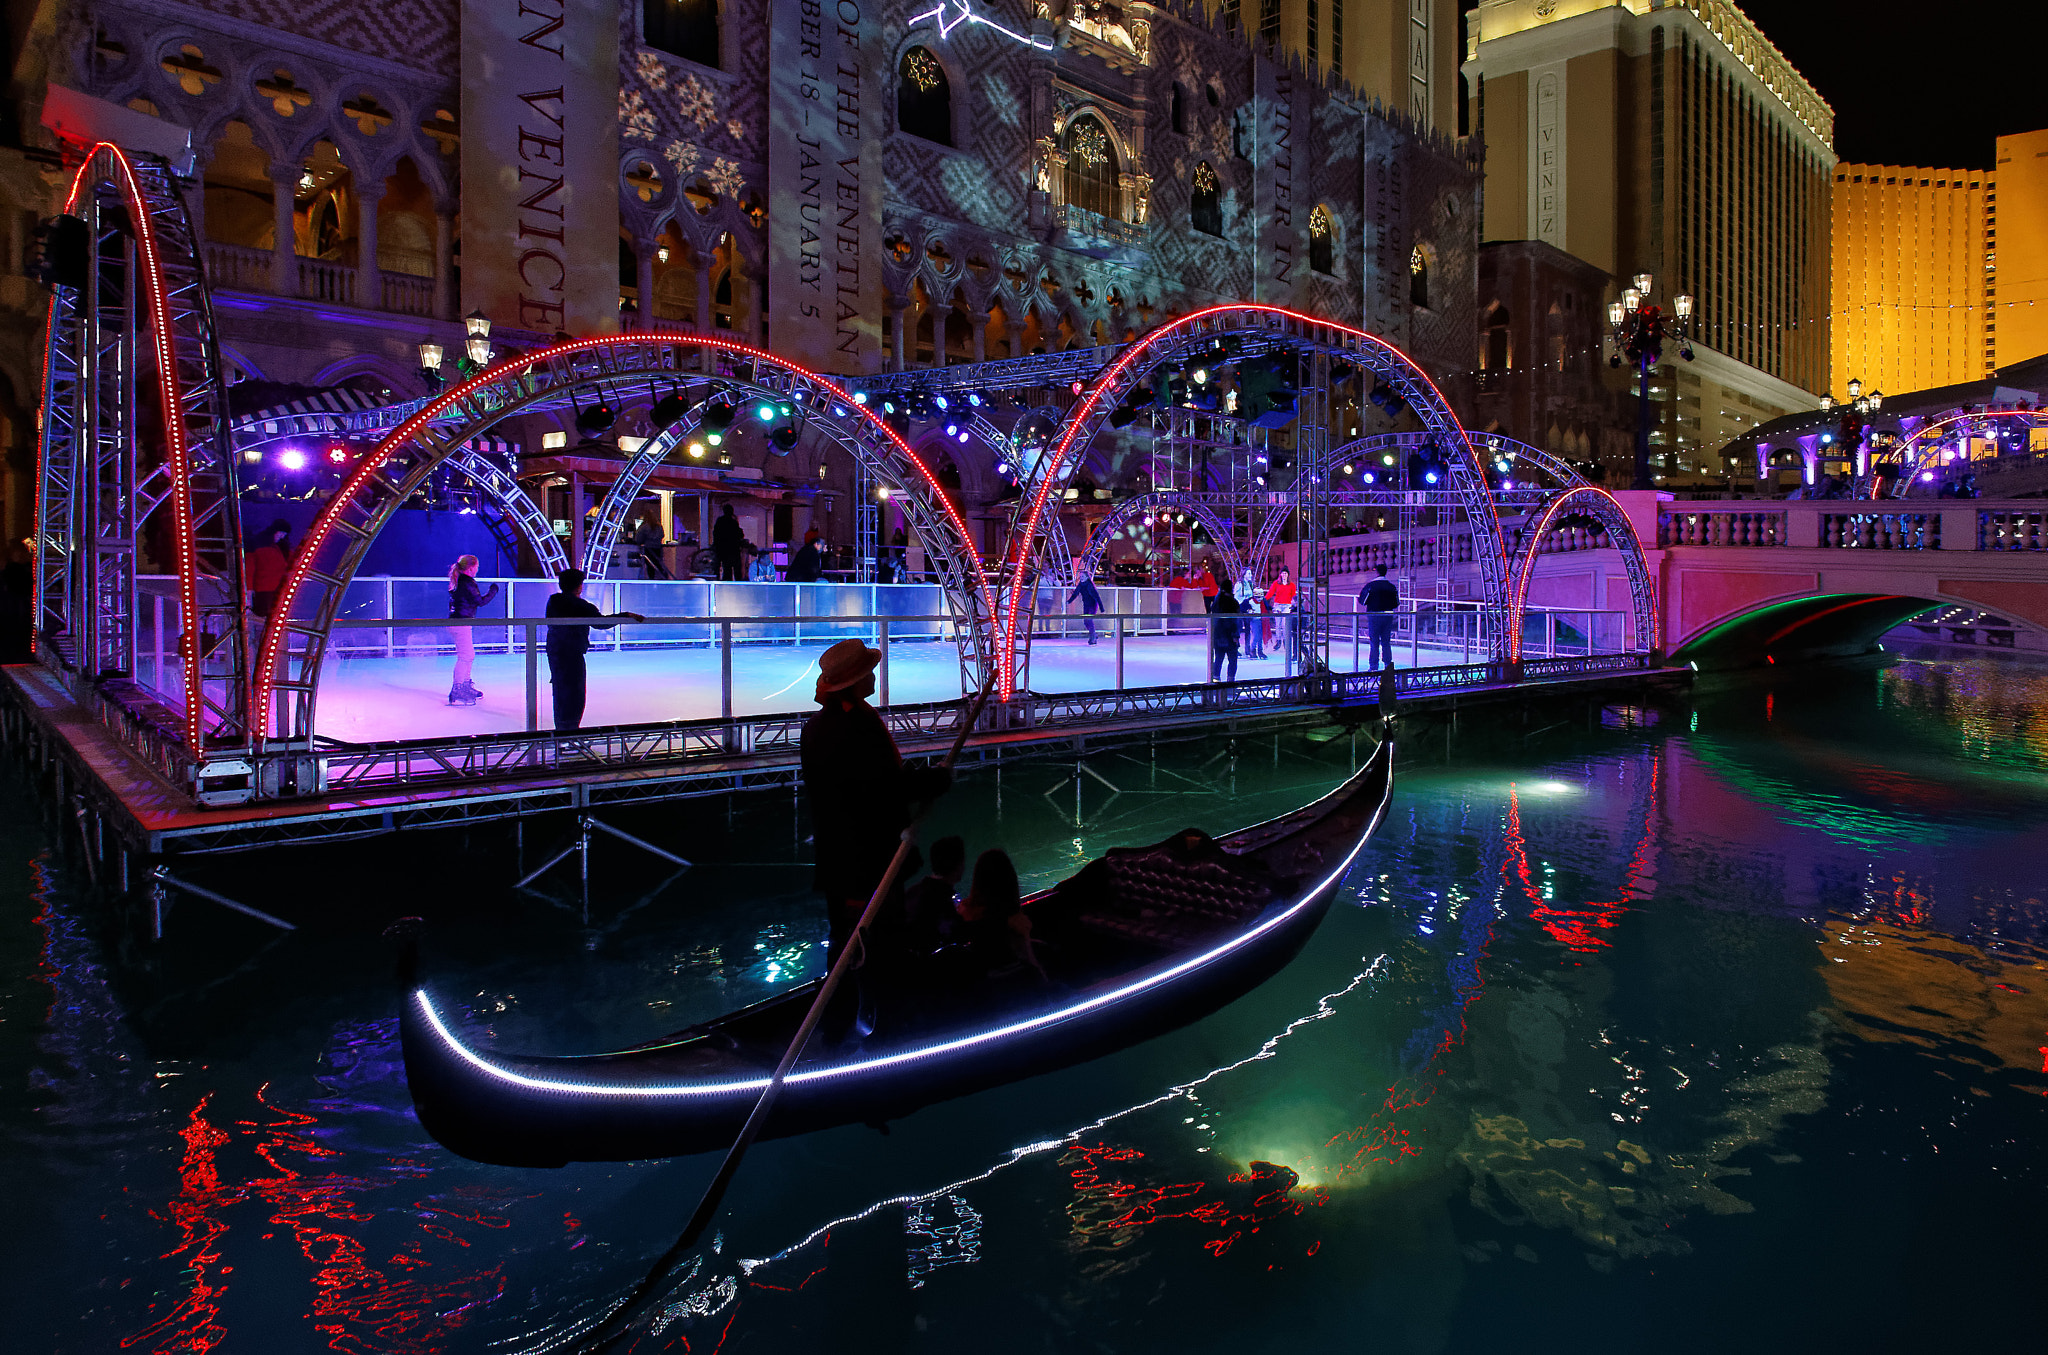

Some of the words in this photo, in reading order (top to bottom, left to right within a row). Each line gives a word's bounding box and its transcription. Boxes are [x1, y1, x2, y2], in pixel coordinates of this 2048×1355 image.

[837, 0, 859, 49] OF
[800, 69, 821, 101] 18
[837, 62, 859, 140] THE
[1275, 74, 1292, 226] WINTER
[1391, 136, 1401, 151] A
[517, 84, 565, 331] VENICE
[1377, 153, 1387, 267] NOVEMBER
[1391, 161, 1401, 215] GIFT
[796, 134, 821, 292] JANUARY
[836, 155, 859, 357] VENETIAN
[1275, 241, 1292, 287] IN
[1391, 227, 1401, 258] OF
[1377, 276, 1387, 293] 18
[1391, 271, 1401, 316] THE
[800, 301, 821, 320] 5
